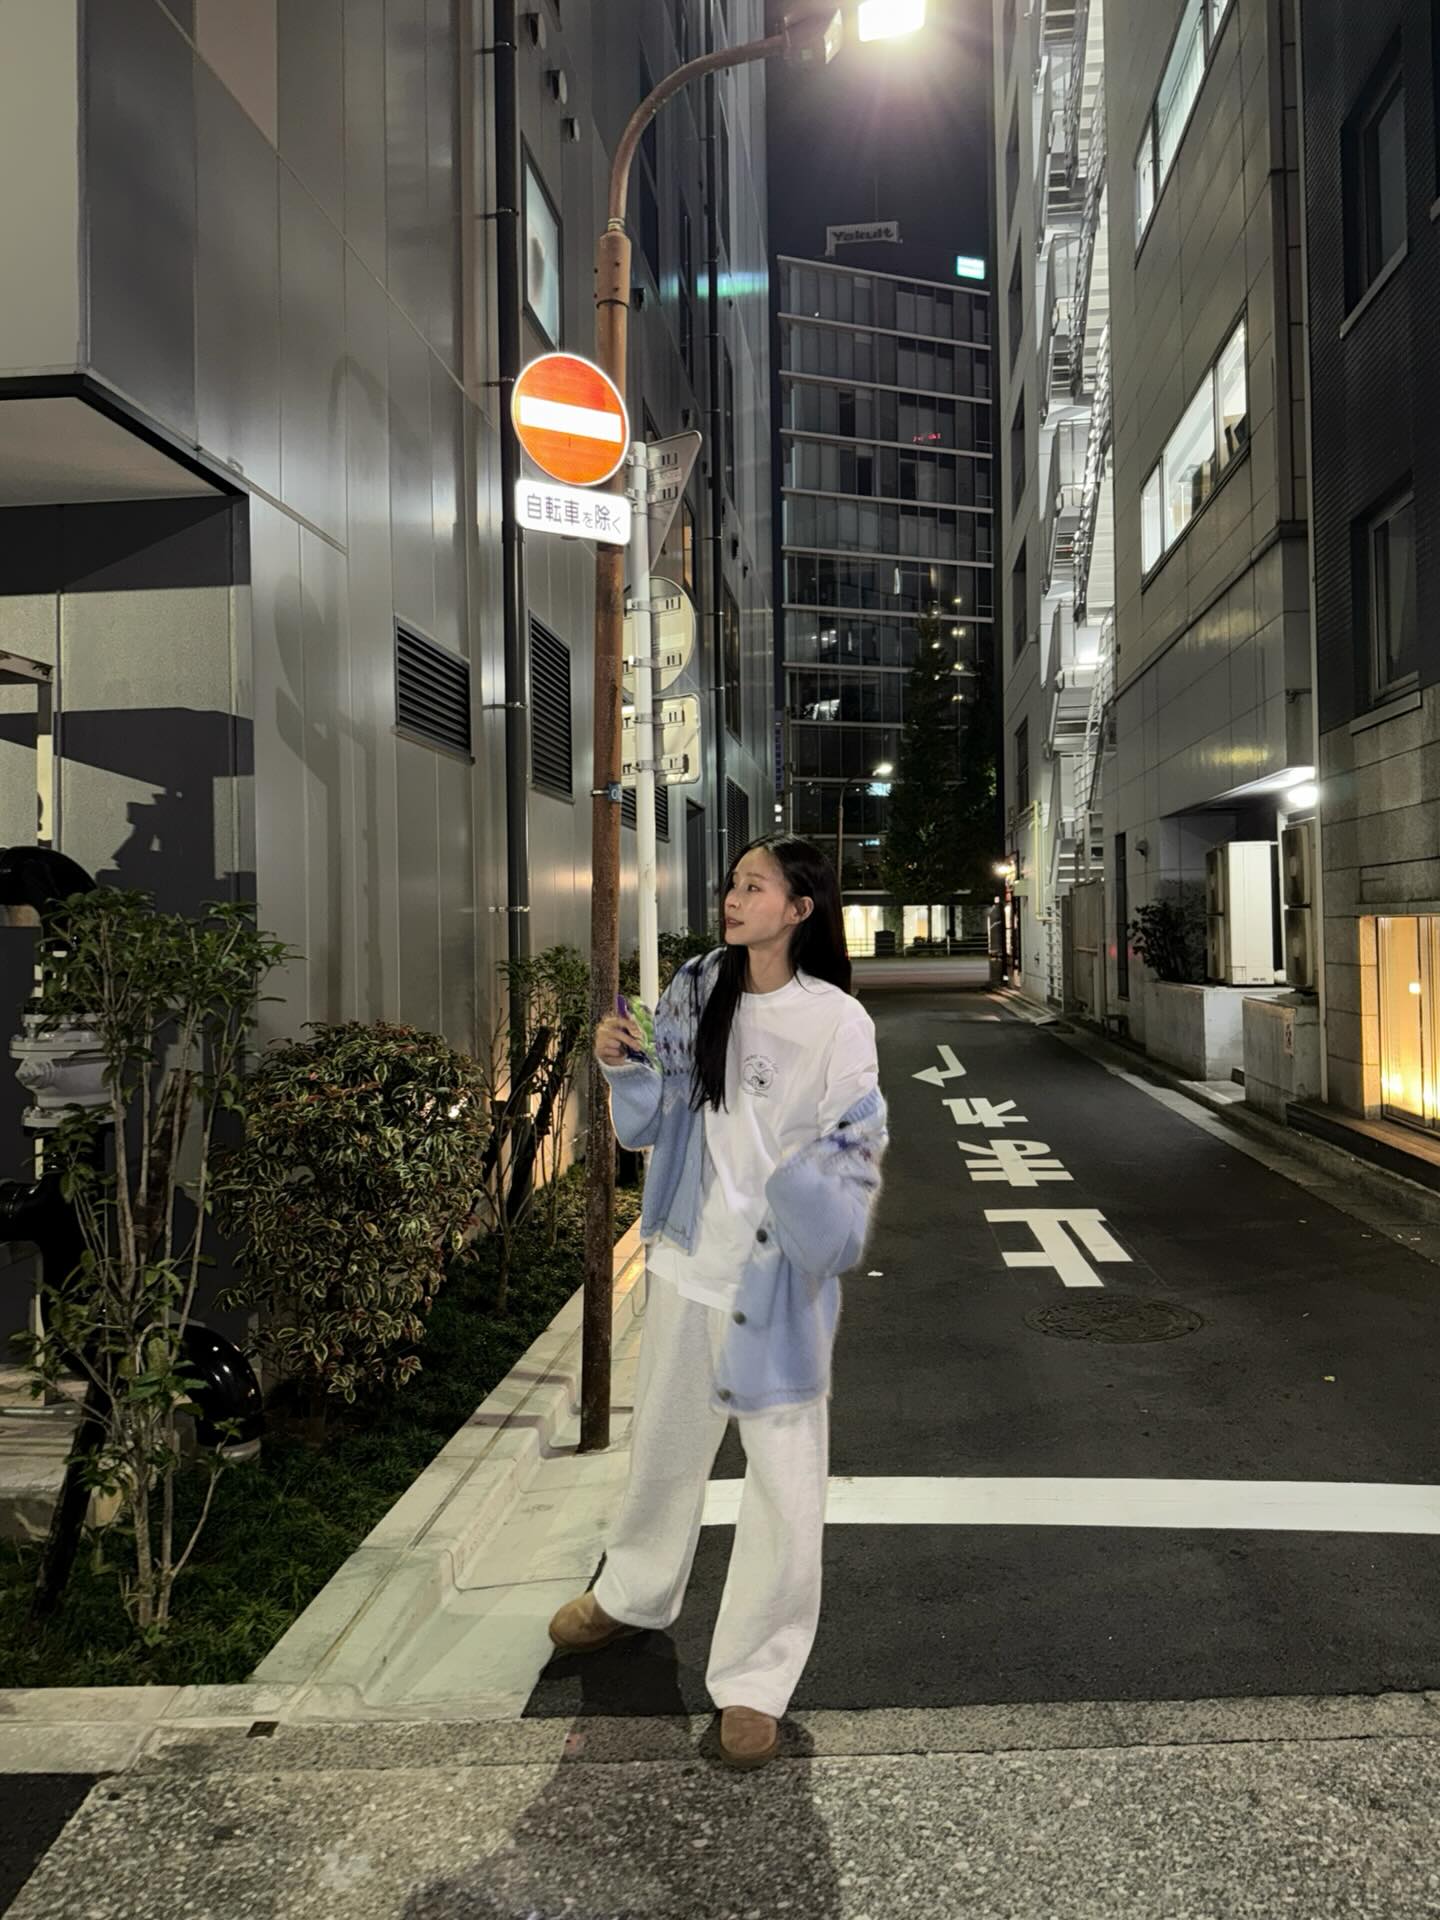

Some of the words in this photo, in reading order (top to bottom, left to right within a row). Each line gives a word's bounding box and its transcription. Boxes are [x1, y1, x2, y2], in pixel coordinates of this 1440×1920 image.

[832, 226, 894, 241] Yakult
[527, 492, 621, 534] 自転車を除く
[942, 1098, 1133, 1288] 止まれ
